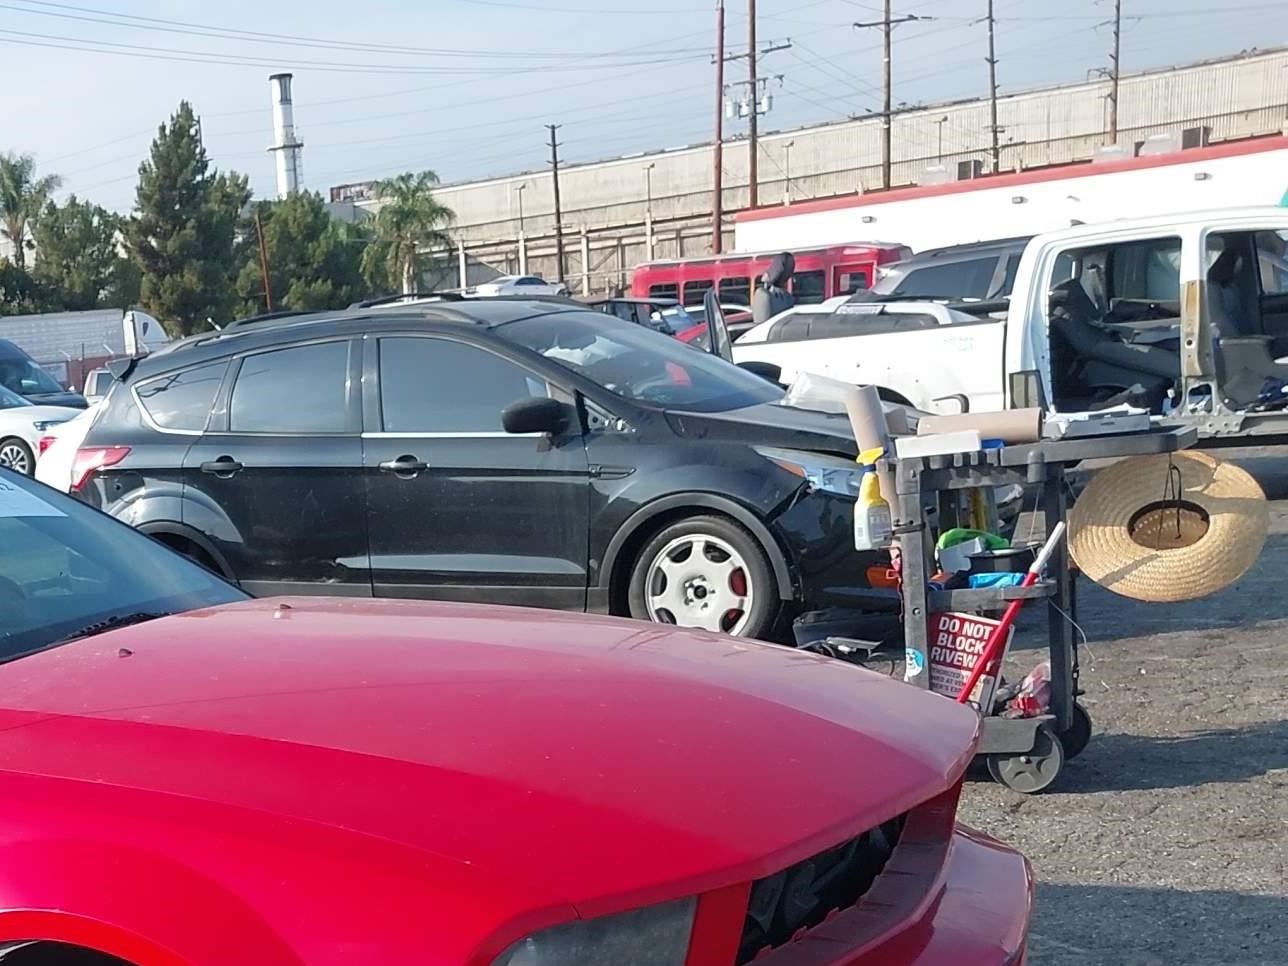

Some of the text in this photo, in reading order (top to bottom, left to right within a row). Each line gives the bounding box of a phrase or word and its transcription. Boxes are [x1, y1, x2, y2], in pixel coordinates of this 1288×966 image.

[938, 616, 993, 640] DO NOT
[937, 632, 986, 654] BLOCK
[931, 646, 992, 672] RIVEW
